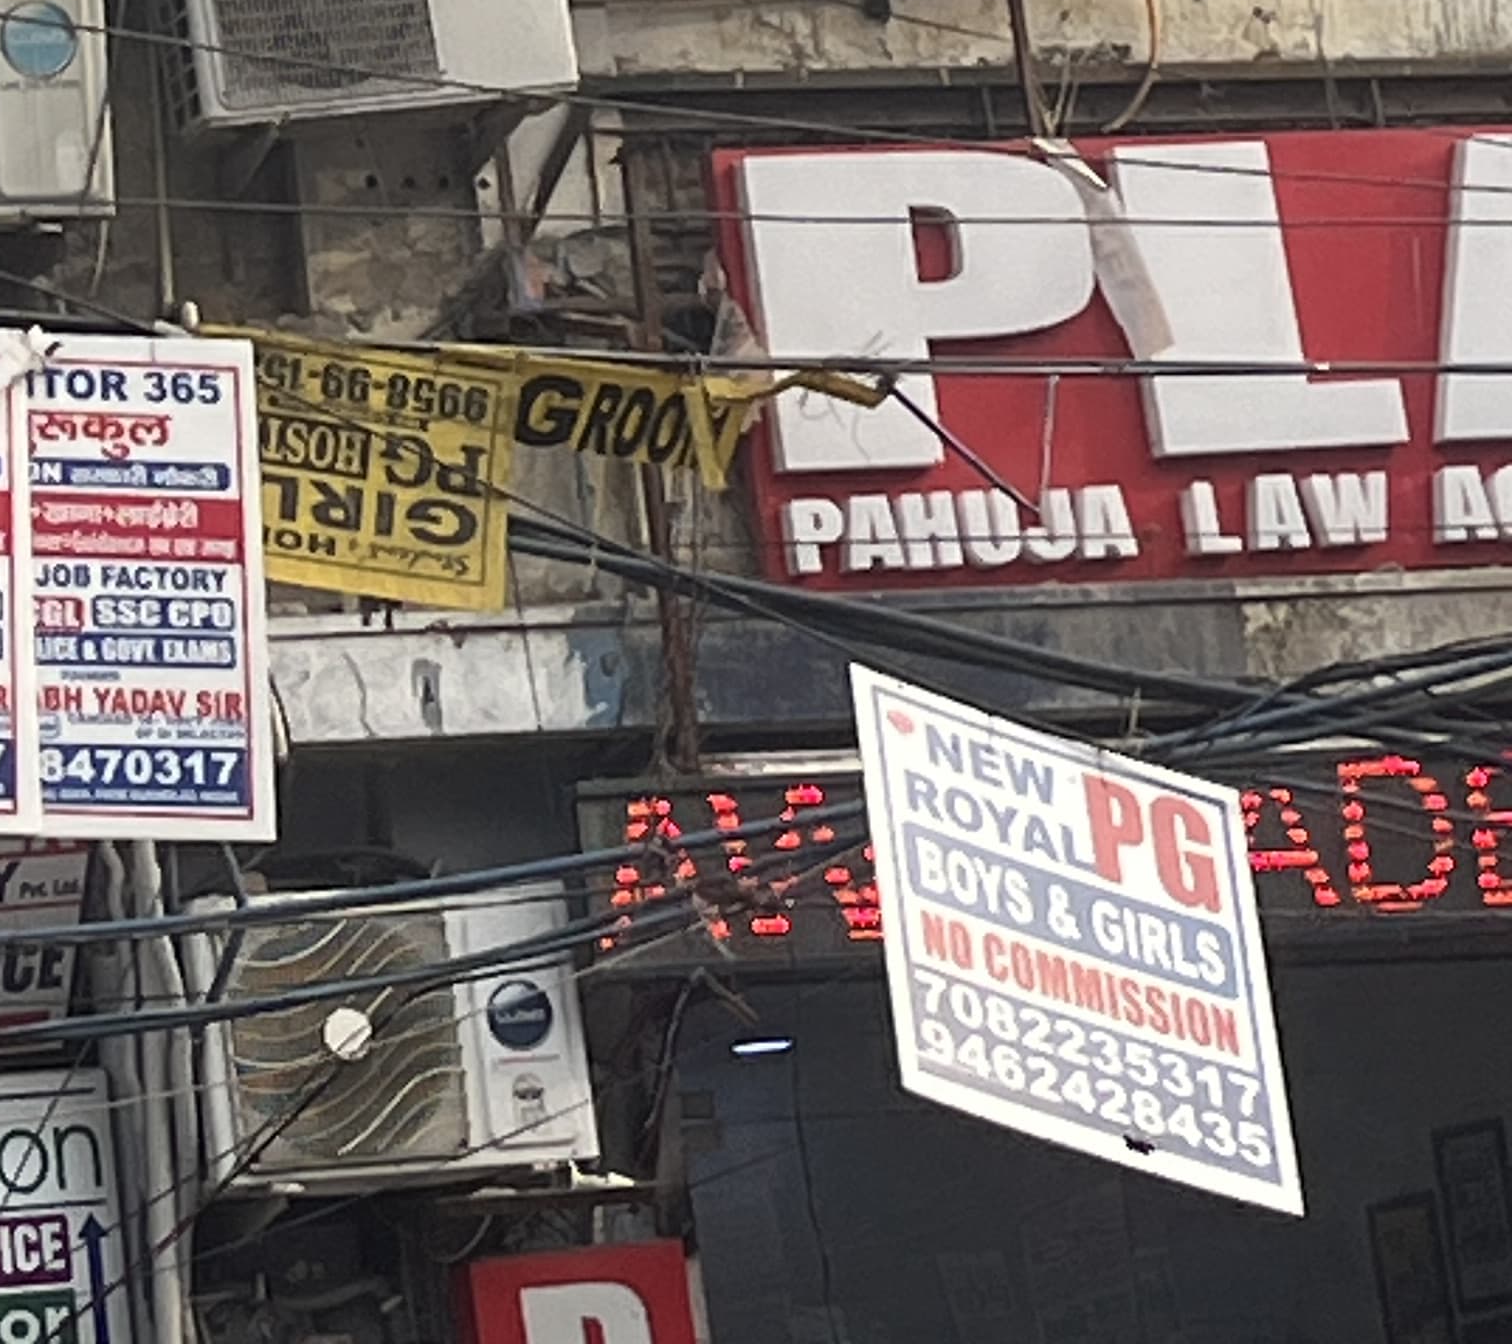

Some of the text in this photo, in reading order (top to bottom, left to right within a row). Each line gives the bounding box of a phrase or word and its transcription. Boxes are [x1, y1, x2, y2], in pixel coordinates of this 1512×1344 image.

[143, 371, 223, 405] 365
[260, 416, 367, 474] HOST
[380, 434, 488, 497] PG
[784, 469, 1391, 576] PAHUJA LAW
[34, 562, 228, 592] JOB FACTORY
[94, 598, 234, 628] SSC CPO
[93, 687, 244, 719] YADAV SIR
[40, 747, 238, 785] 8470317
[925, 723, 1055, 806] NEW
[903, 770, 1098, 874] ROYAL
[1082, 771, 1223, 916] PG
[915, 834, 1032, 927] BOYS
[1047, 883, 1083, 942] &
[1091, 899, 1227, 987] GIRLS
[920, 909, 1241, 1058] NO COMMISSION
[913, 968, 1263, 1118] 7082235317
[919, 1016, 1275, 1169] 9462428435
